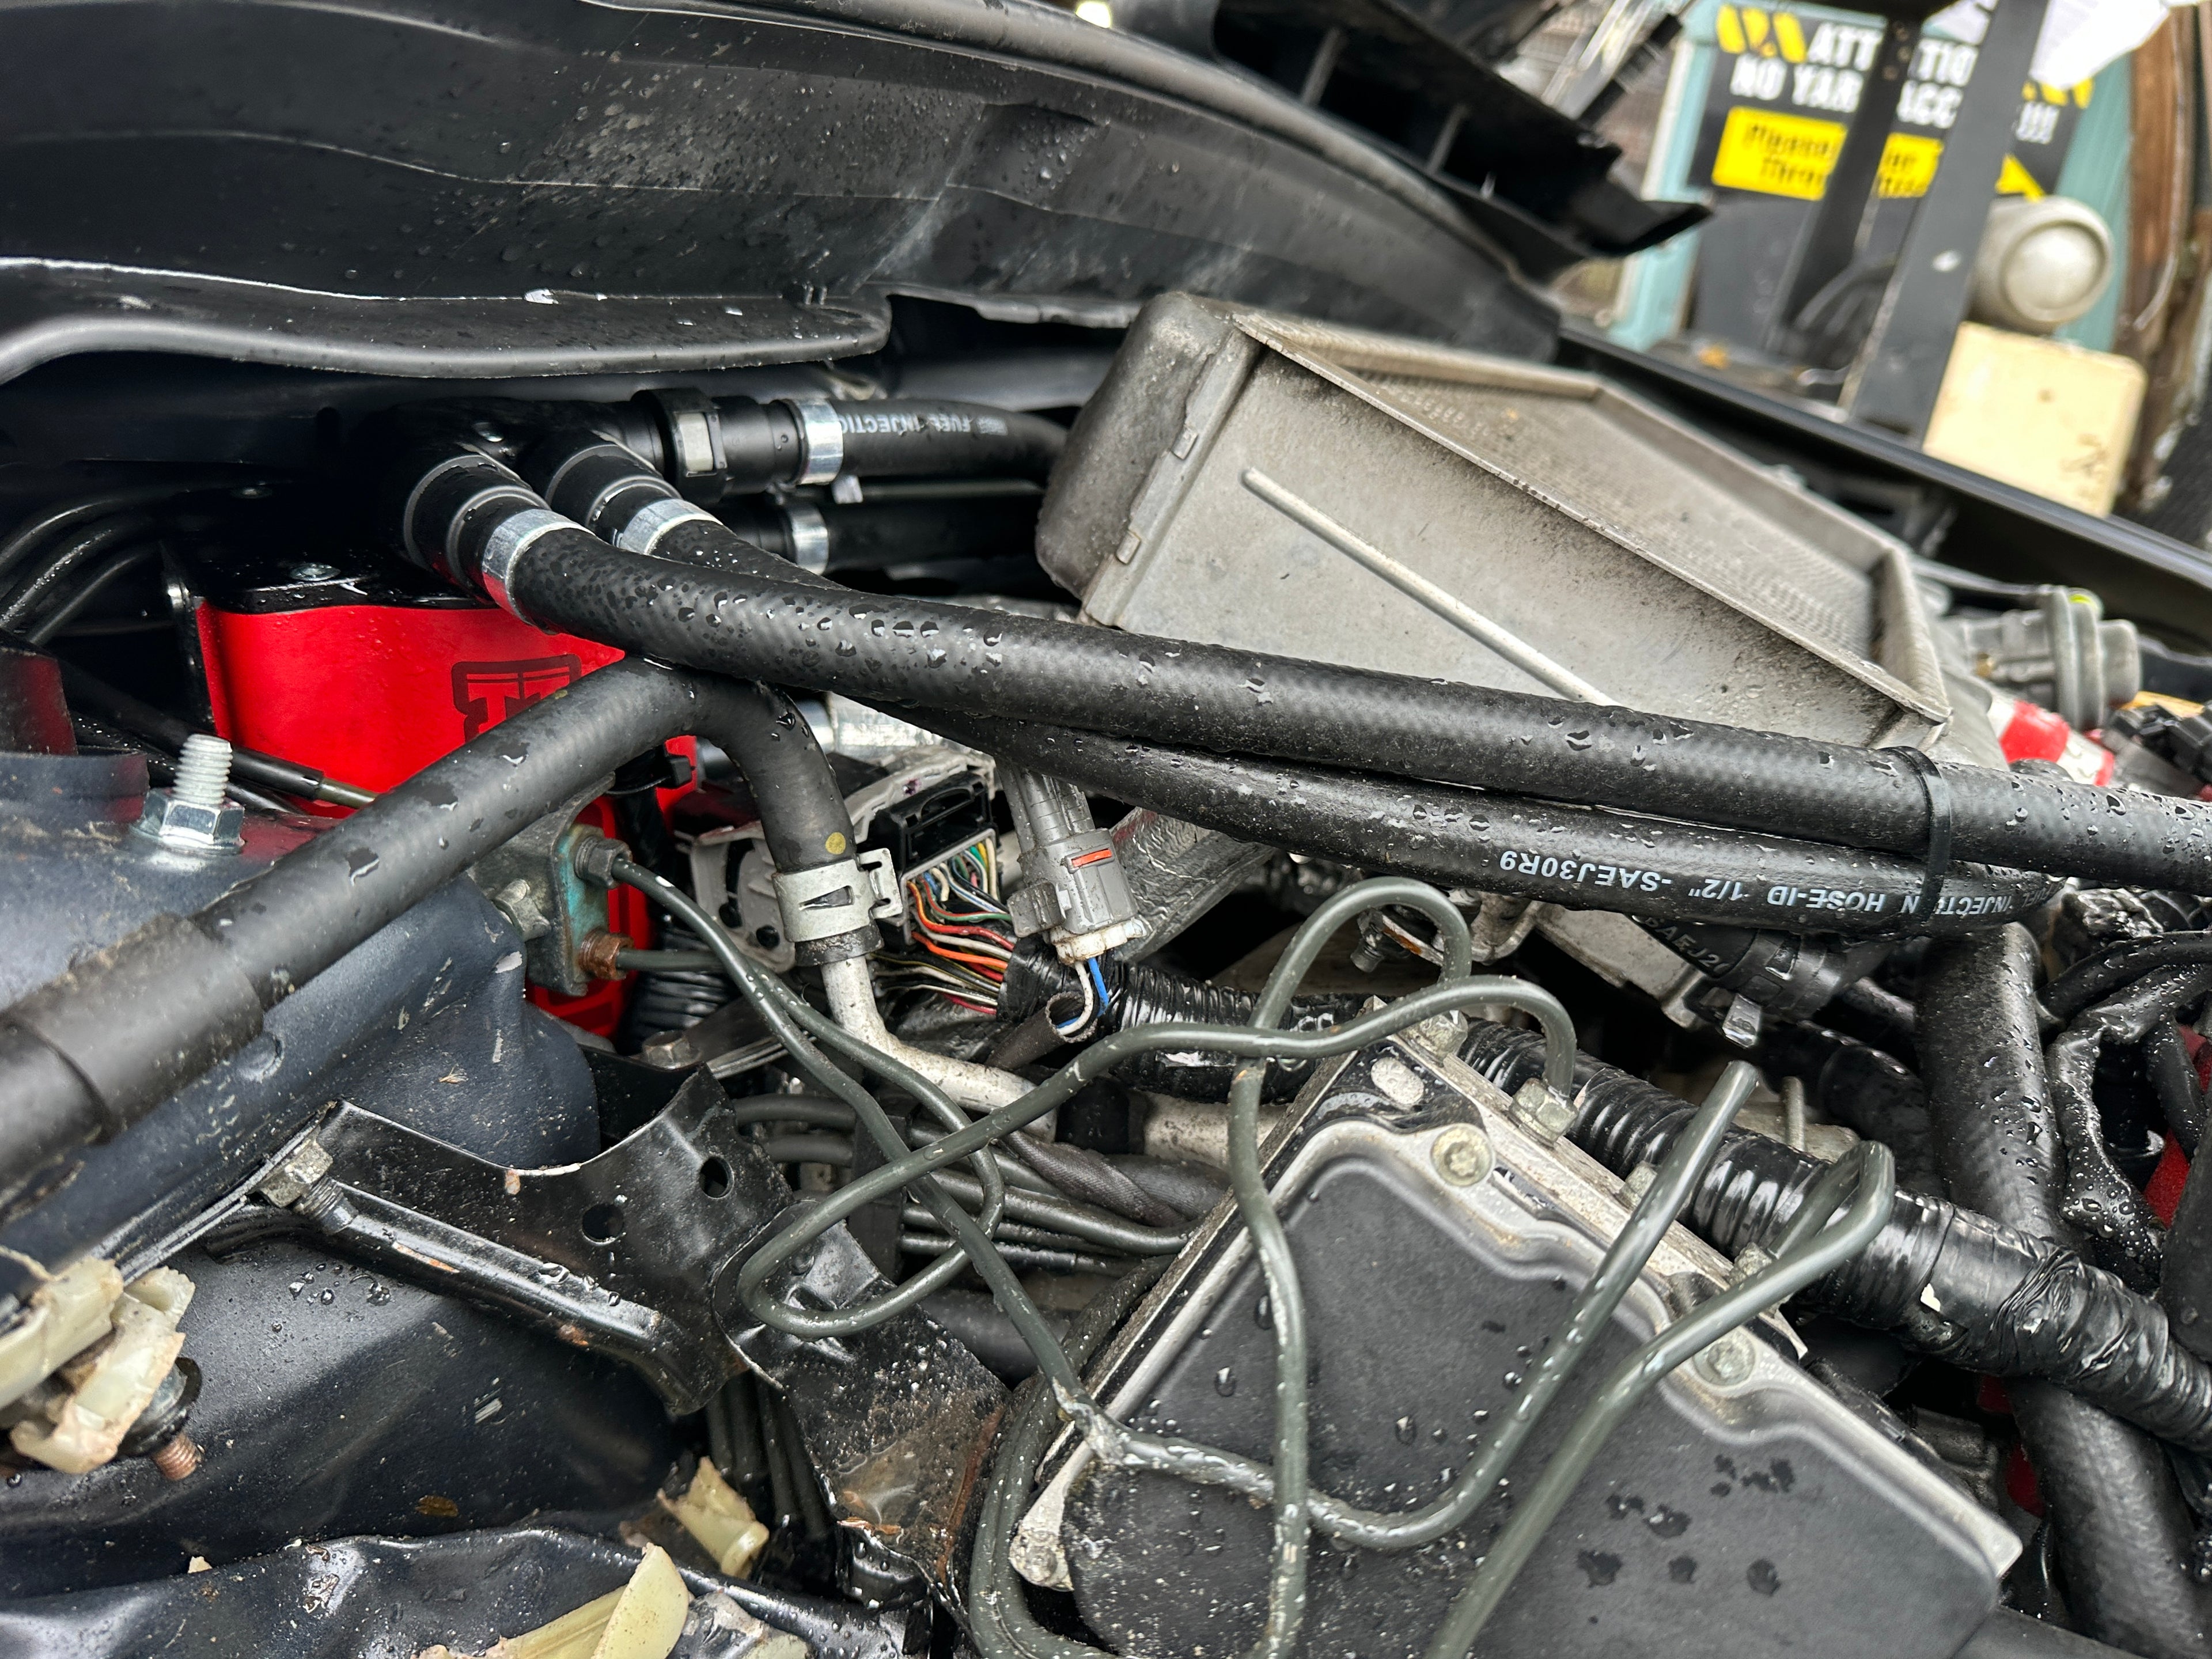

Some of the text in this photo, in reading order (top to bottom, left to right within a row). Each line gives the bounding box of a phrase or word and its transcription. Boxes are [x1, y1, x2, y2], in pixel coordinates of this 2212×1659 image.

[1730, 54, 1787, 100] NO
[1792, 65, 1864, 113] YAR
[838, 413, 922, 434] INJECTIO
[1688, 878, 1745, 901] 1/2"
[1767, 885, 1886, 912] HOSE-ID
[1900, 895, 2013, 915] INJECTIN
